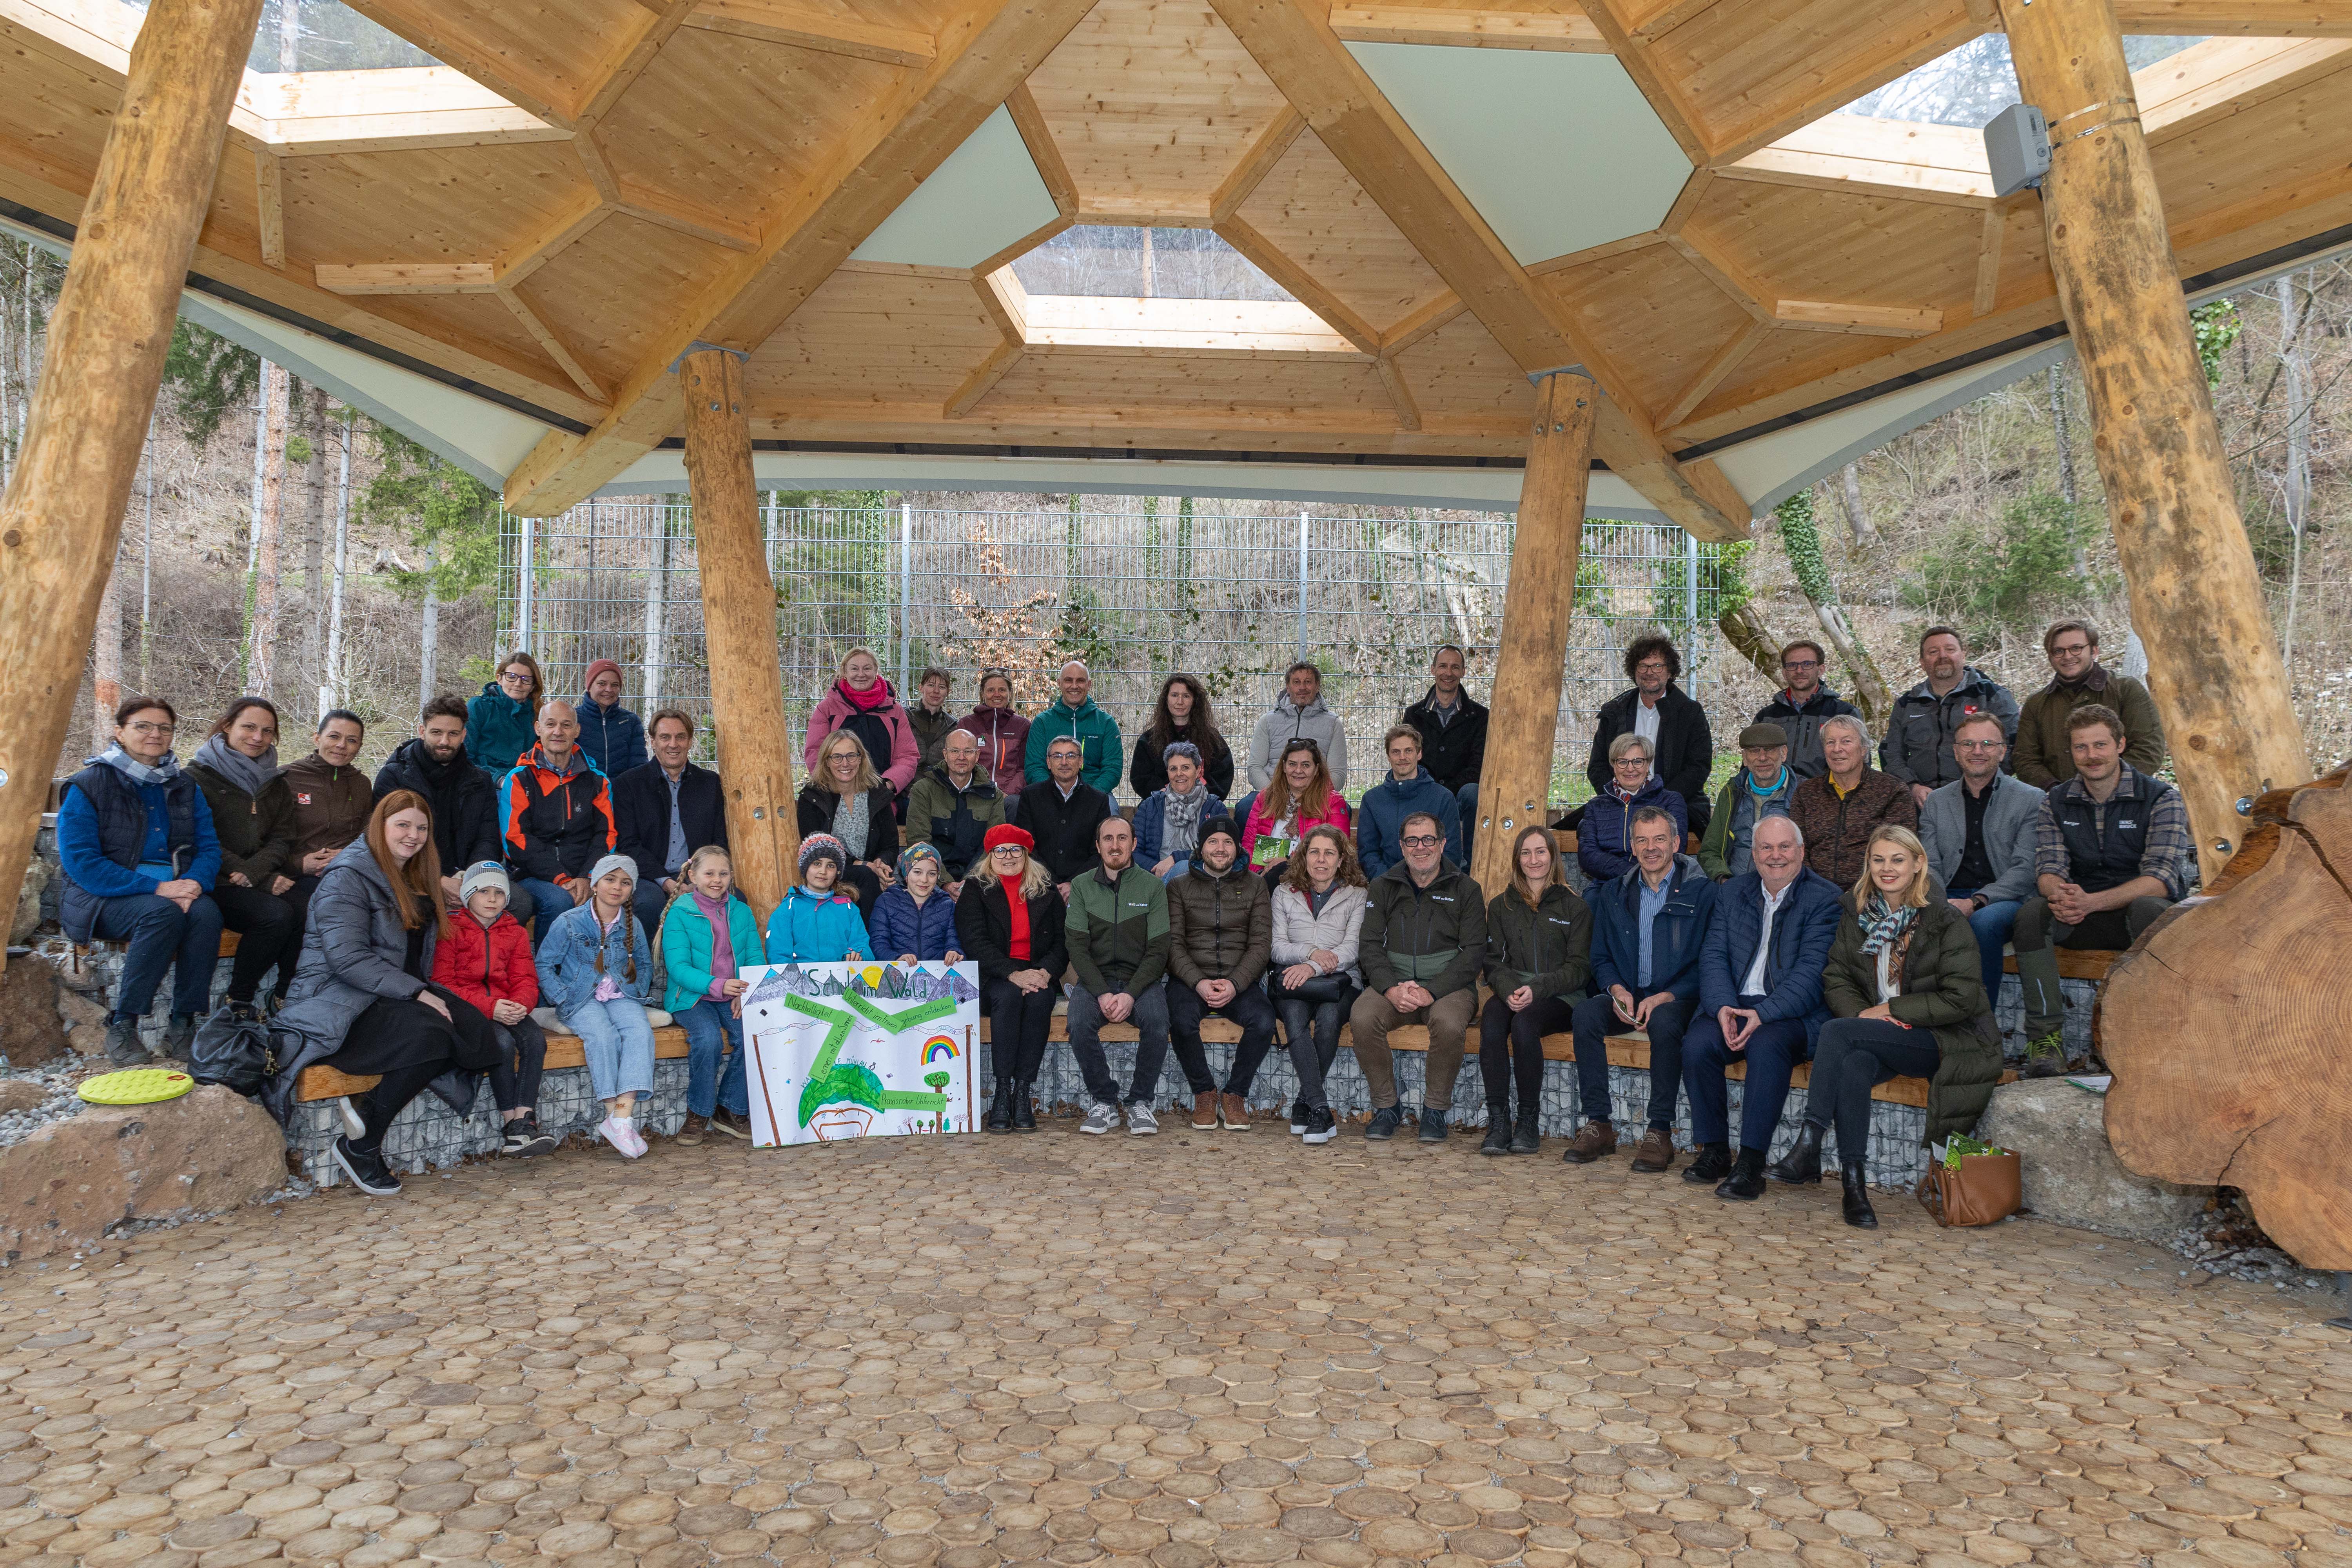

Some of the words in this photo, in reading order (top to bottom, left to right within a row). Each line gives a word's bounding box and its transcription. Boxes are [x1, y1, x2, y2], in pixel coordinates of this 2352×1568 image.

[862, 981, 877, 997] im
[884, 972, 927, 999] Wald
[788, 996, 833, 1019] Nachhaltigkeit
[844, 989, 873, 1014] Unterricht
[873, 1012, 882, 1021] im
[881, 1014, 898, 1029] Freien
[902, 1013, 923, 1027] gebung
[925, 1004, 951, 1016] entdecken
[837, 1015, 853, 1031] Sinnen
[833, 1031, 846, 1045] allen
[829, 1043, 837, 1054] mit
[811, 1057, 832, 1080] Lernen
[847, 1055, 867, 1067] MÜHLAU
[882, 1093, 914, 1105] Praxisnaher
[916, 1094, 944, 1105] Unterricht
